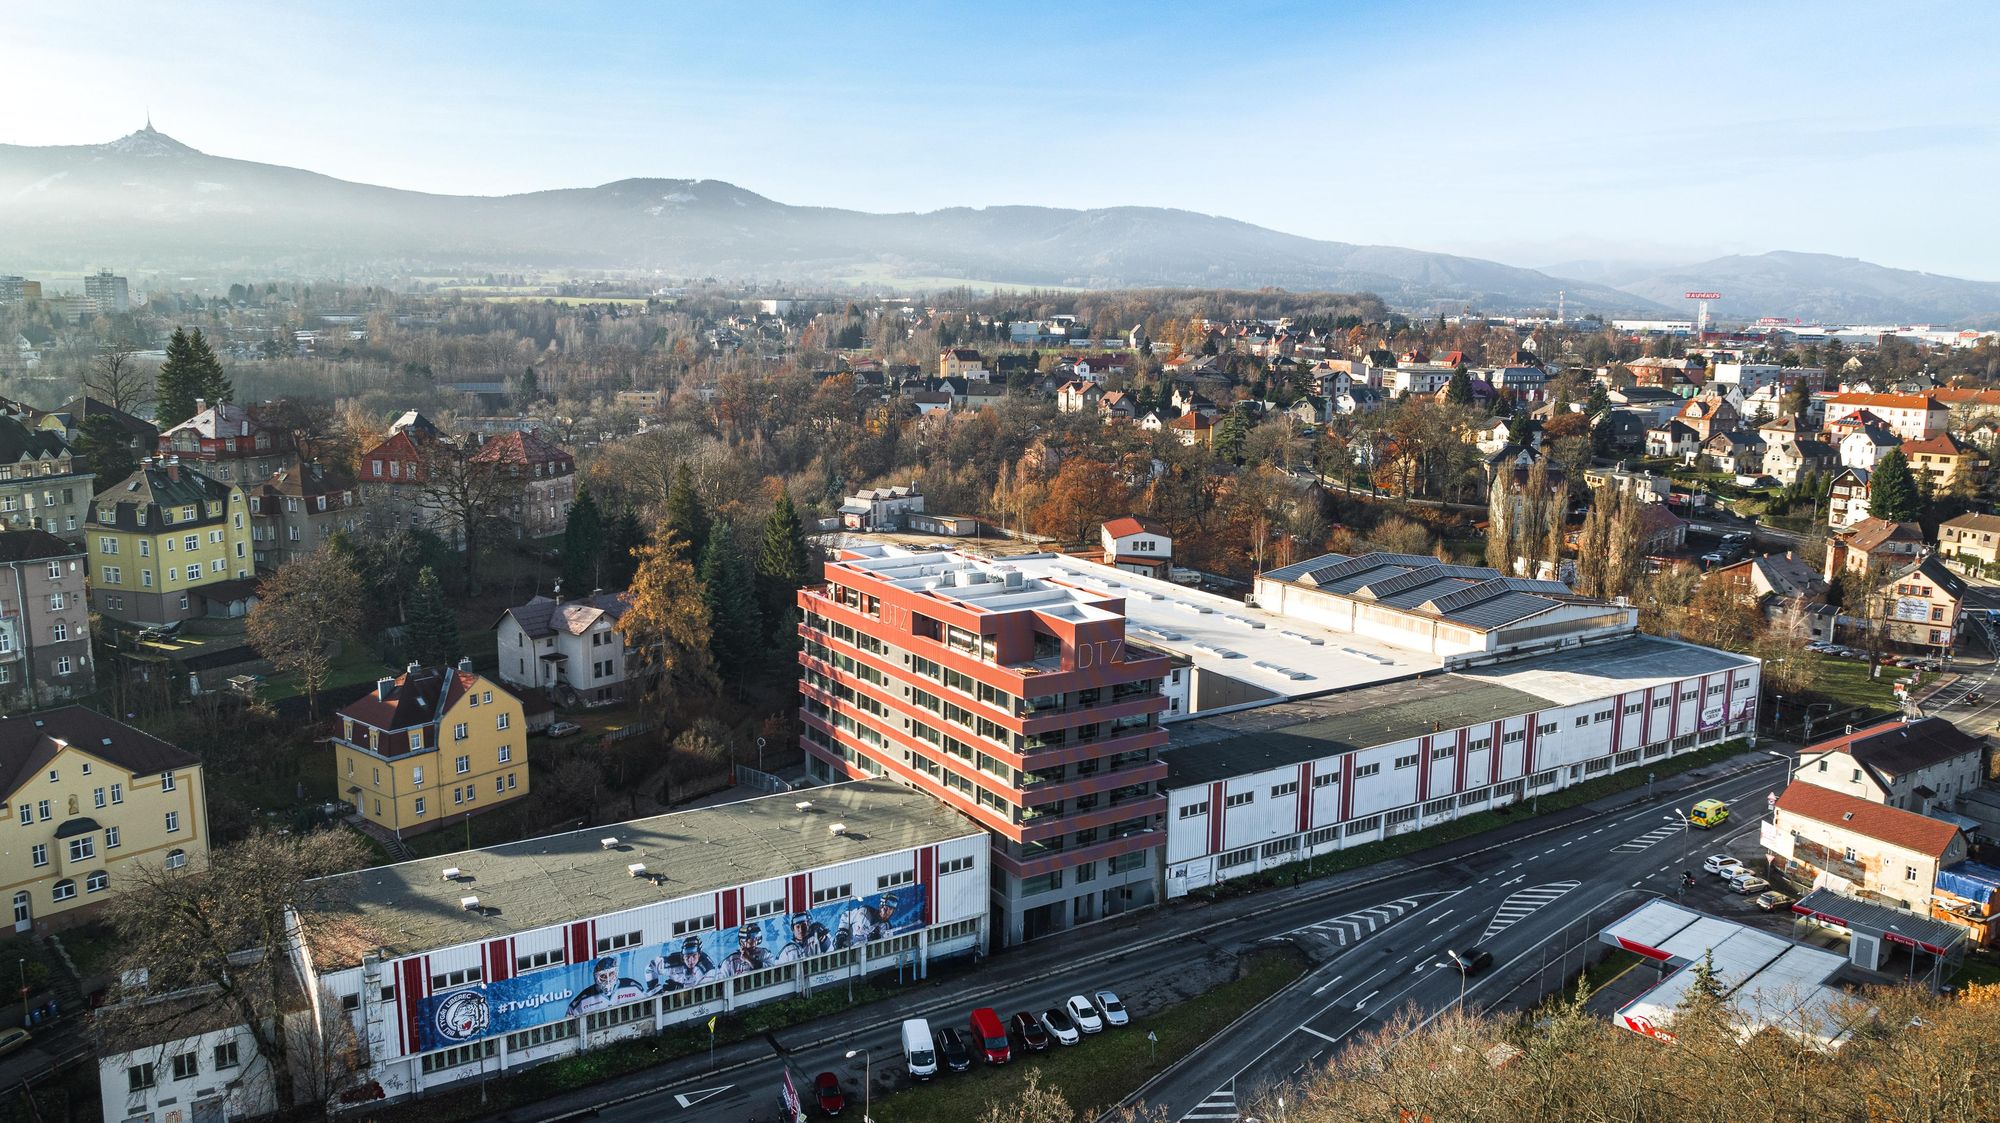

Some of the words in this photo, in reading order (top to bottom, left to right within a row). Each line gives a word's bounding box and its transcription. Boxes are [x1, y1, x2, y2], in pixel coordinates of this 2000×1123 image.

[883, 601, 908, 632] DTZ
[1078, 638, 1123, 669] DTZ
[446, 993, 472, 1008] LIBEREC
[497, 988, 573, 1013] #TvůjKlub
[617, 992, 636, 1000] SYNER
